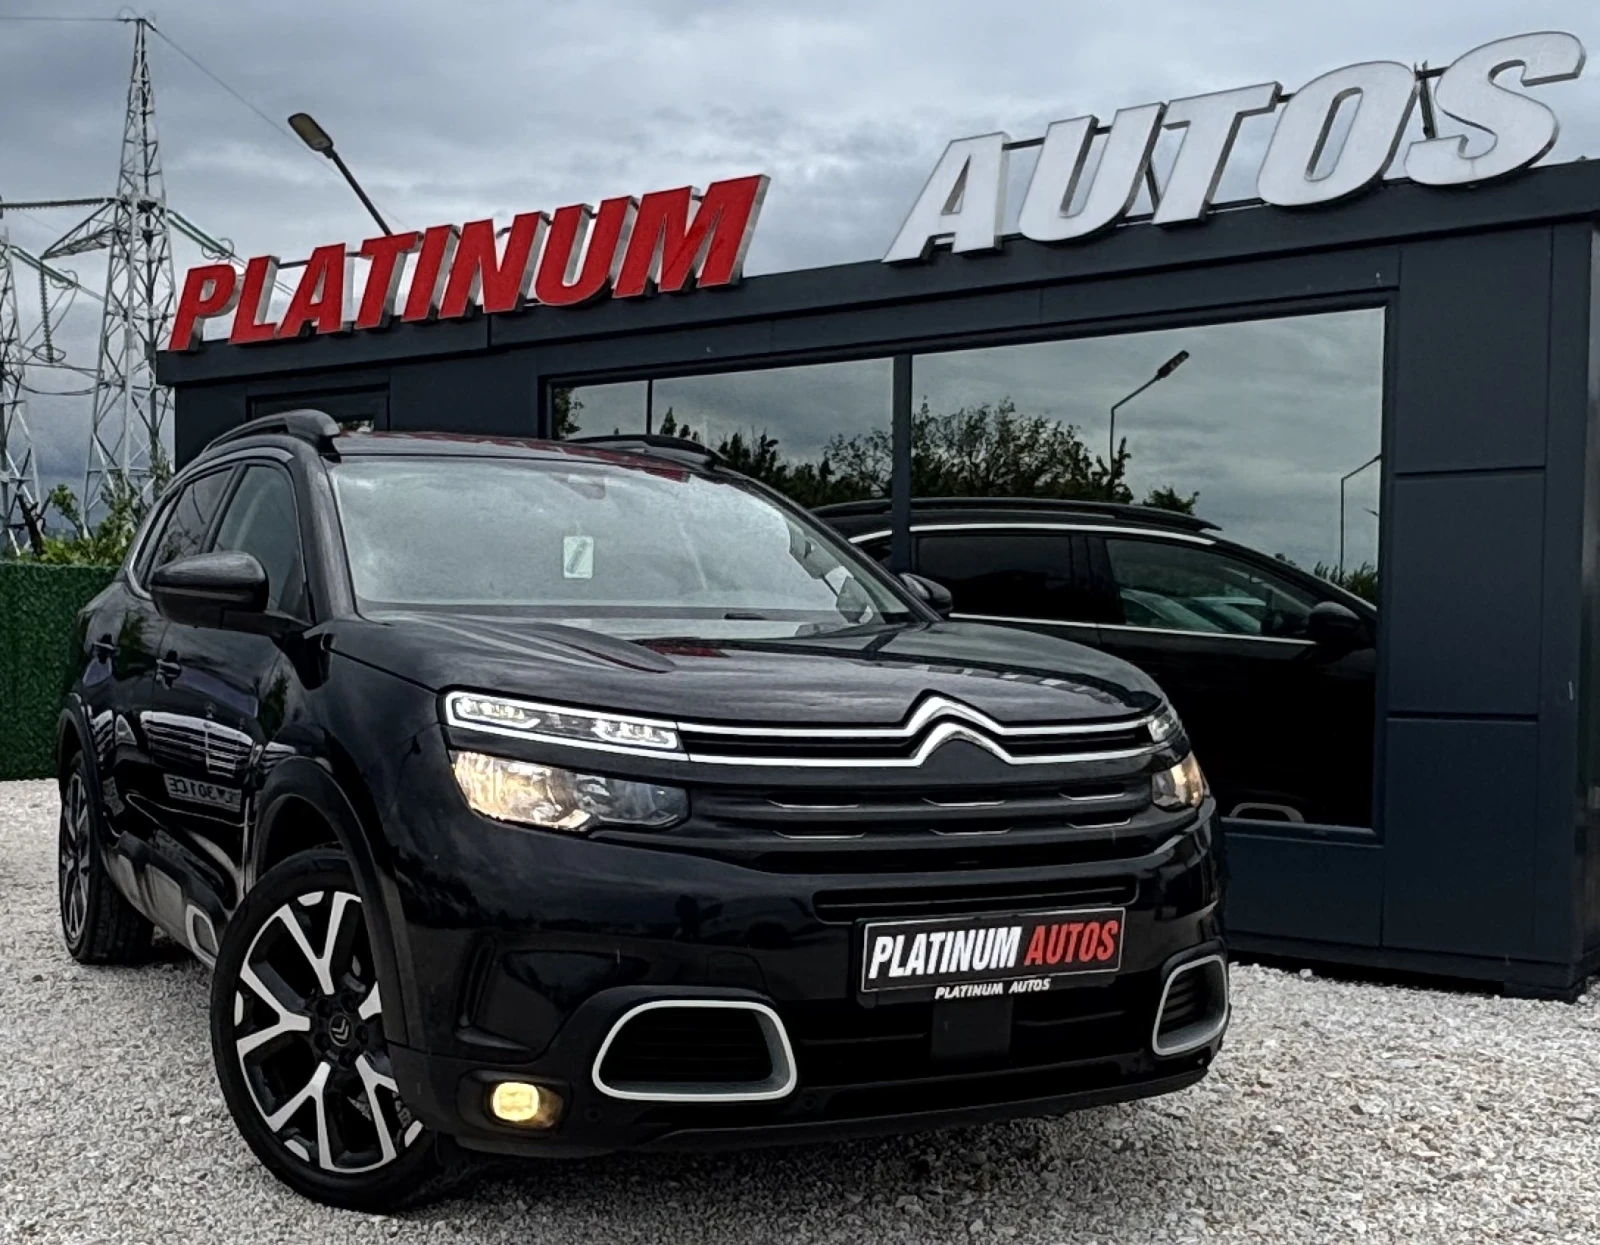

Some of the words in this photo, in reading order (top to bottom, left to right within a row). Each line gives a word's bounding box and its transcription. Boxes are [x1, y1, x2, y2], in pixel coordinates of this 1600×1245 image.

[169, 174, 770, 352] PLATINUM
[883, 30, 1587, 264] AUTOS
[869, 927, 1022, 978] PLATINUM
[1024, 920, 1118, 966] AUTOS
[935, 983, 1003, 999] PLATINUM
[1009, 979, 1051, 994] AUTOS
